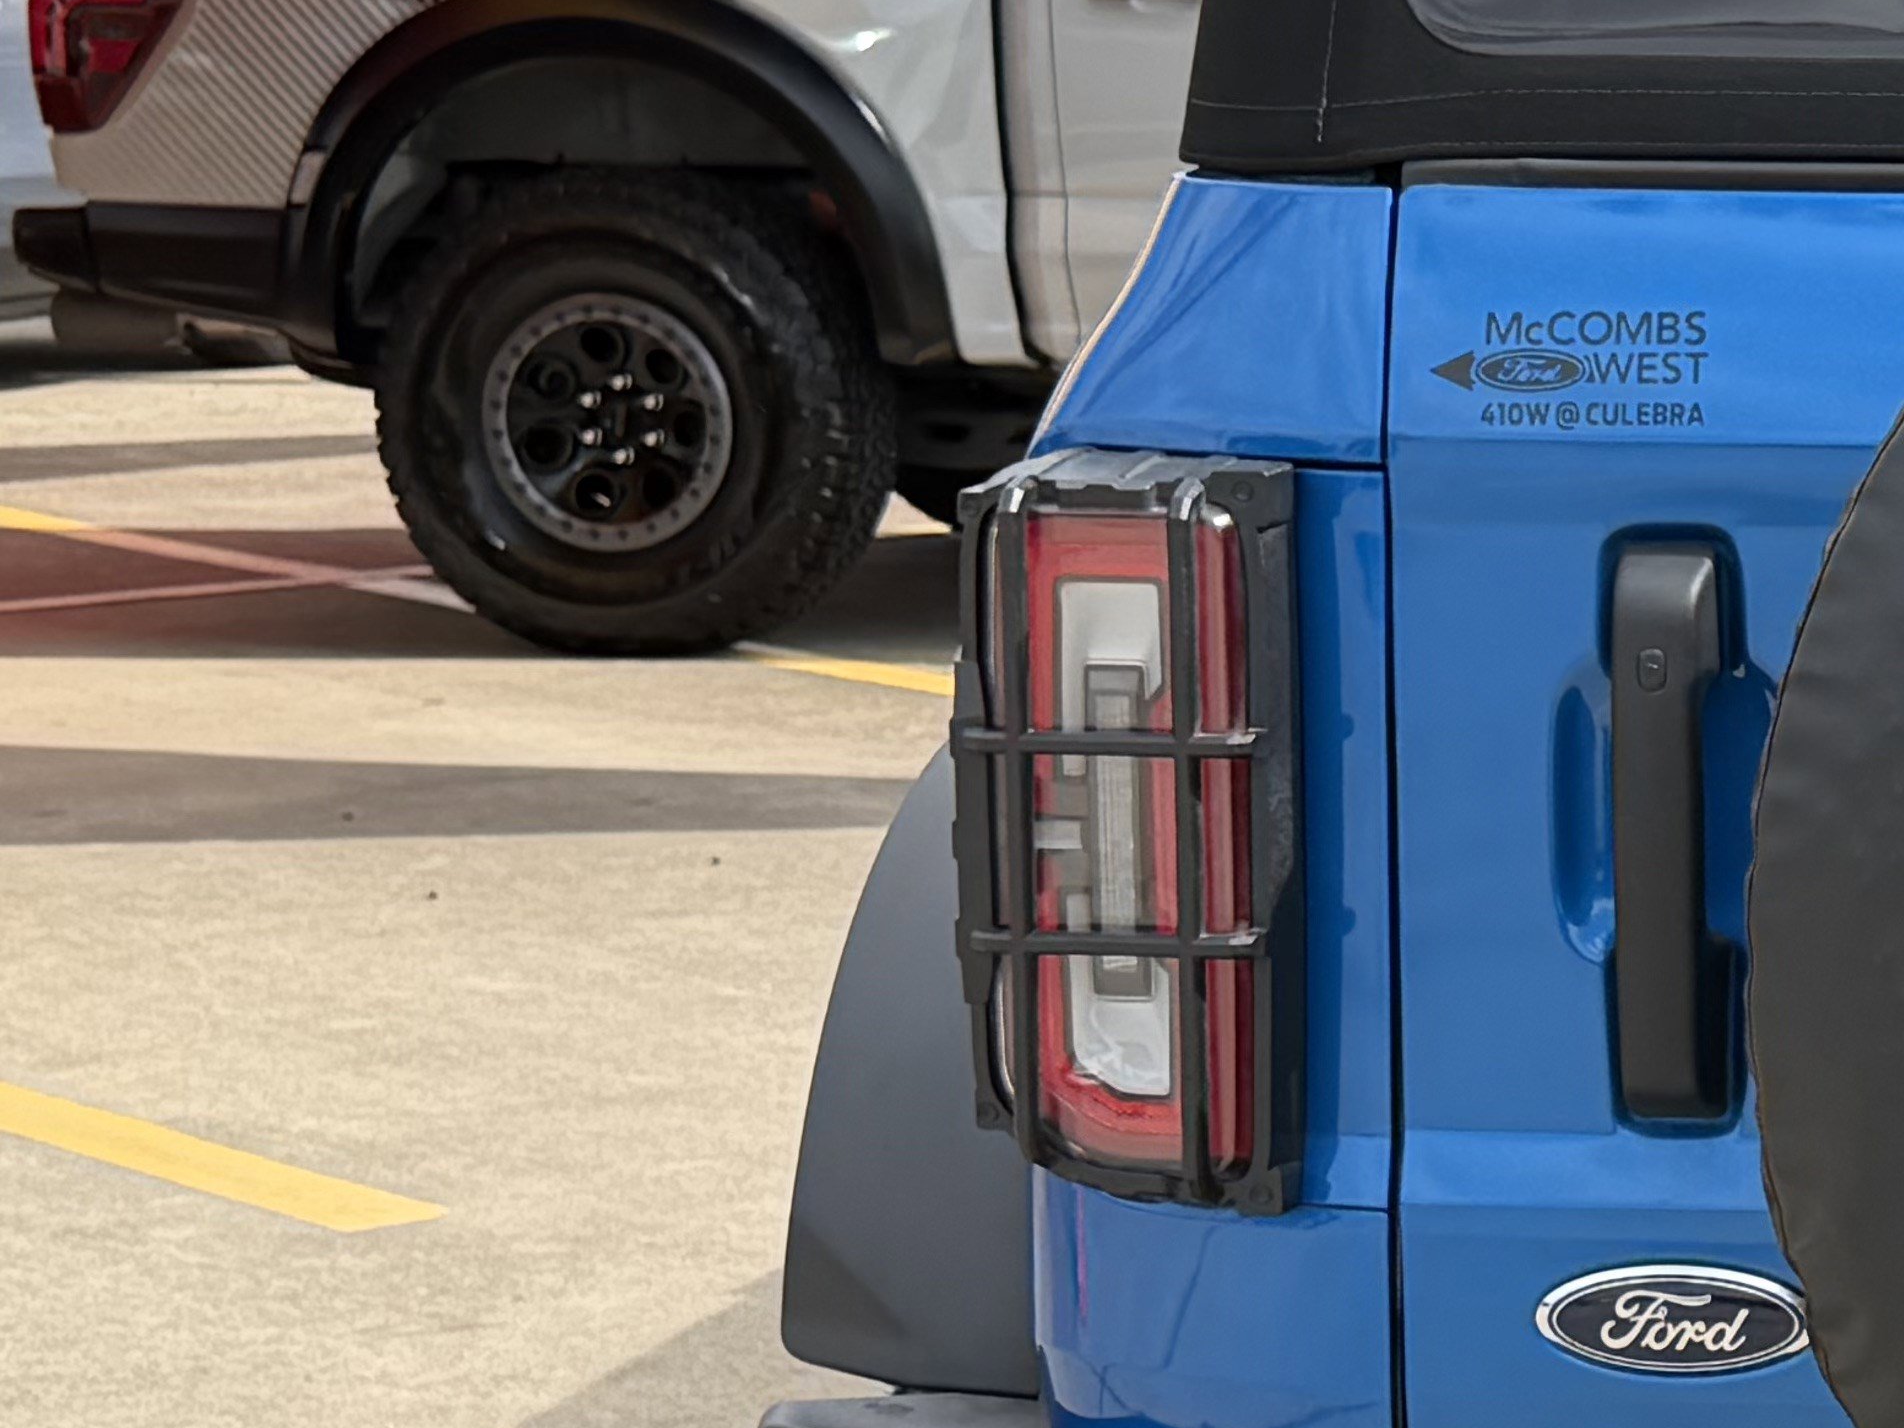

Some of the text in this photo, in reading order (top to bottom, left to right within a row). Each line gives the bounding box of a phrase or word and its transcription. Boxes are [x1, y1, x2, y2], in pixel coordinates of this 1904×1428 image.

[1485, 310, 1707, 346] McCOMBS
[1497, 352, 1709, 385] Ford WEST
[1585, 402, 1704, 427] CULEBRA
[1599, 1289, 1750, 1352] Ford
